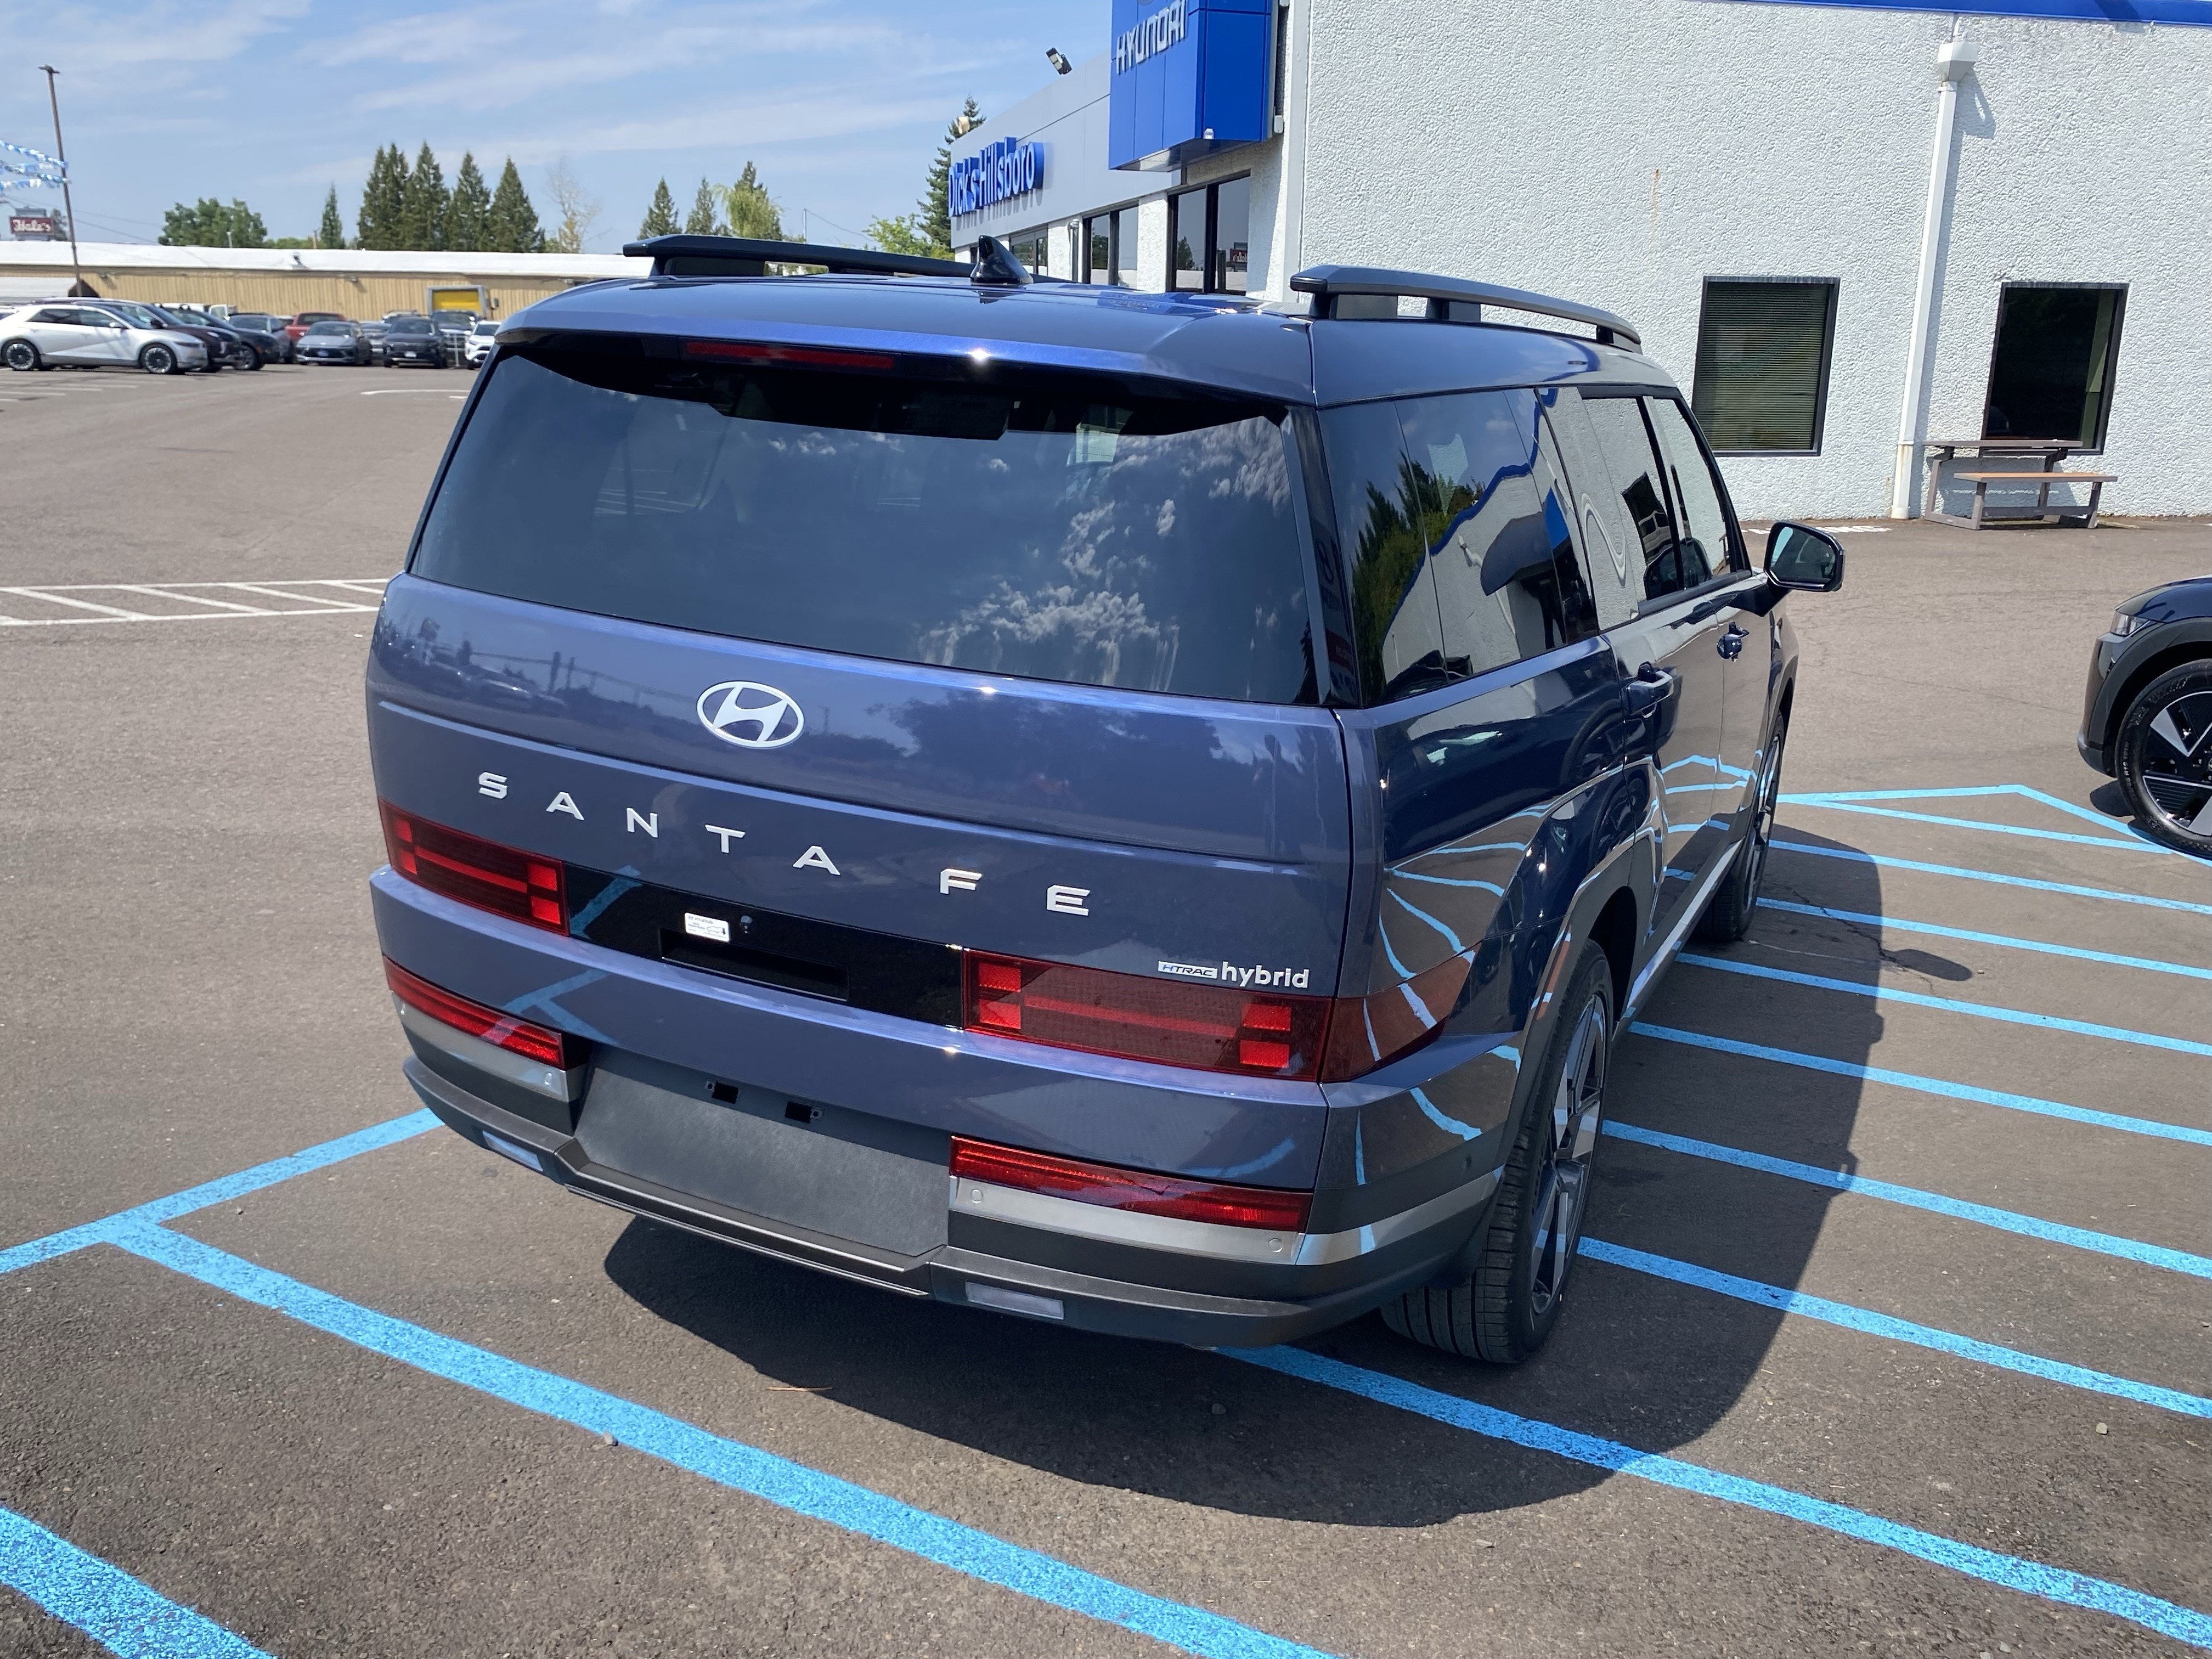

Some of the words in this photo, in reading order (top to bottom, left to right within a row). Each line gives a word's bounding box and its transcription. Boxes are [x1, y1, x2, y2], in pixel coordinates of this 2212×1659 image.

[1116, 0, 1187, 75] HYUNDAI
[949, 157, 978, 217] Dick's
[979, 137, 1040, 207] Hillsboro
[478, 771, 840, 876] SANTA
[940, 868, 1090, 916] FE
[1161, 963, 1214, 977] HTRAC
[1221, 961, 1310, 989] hybrid
